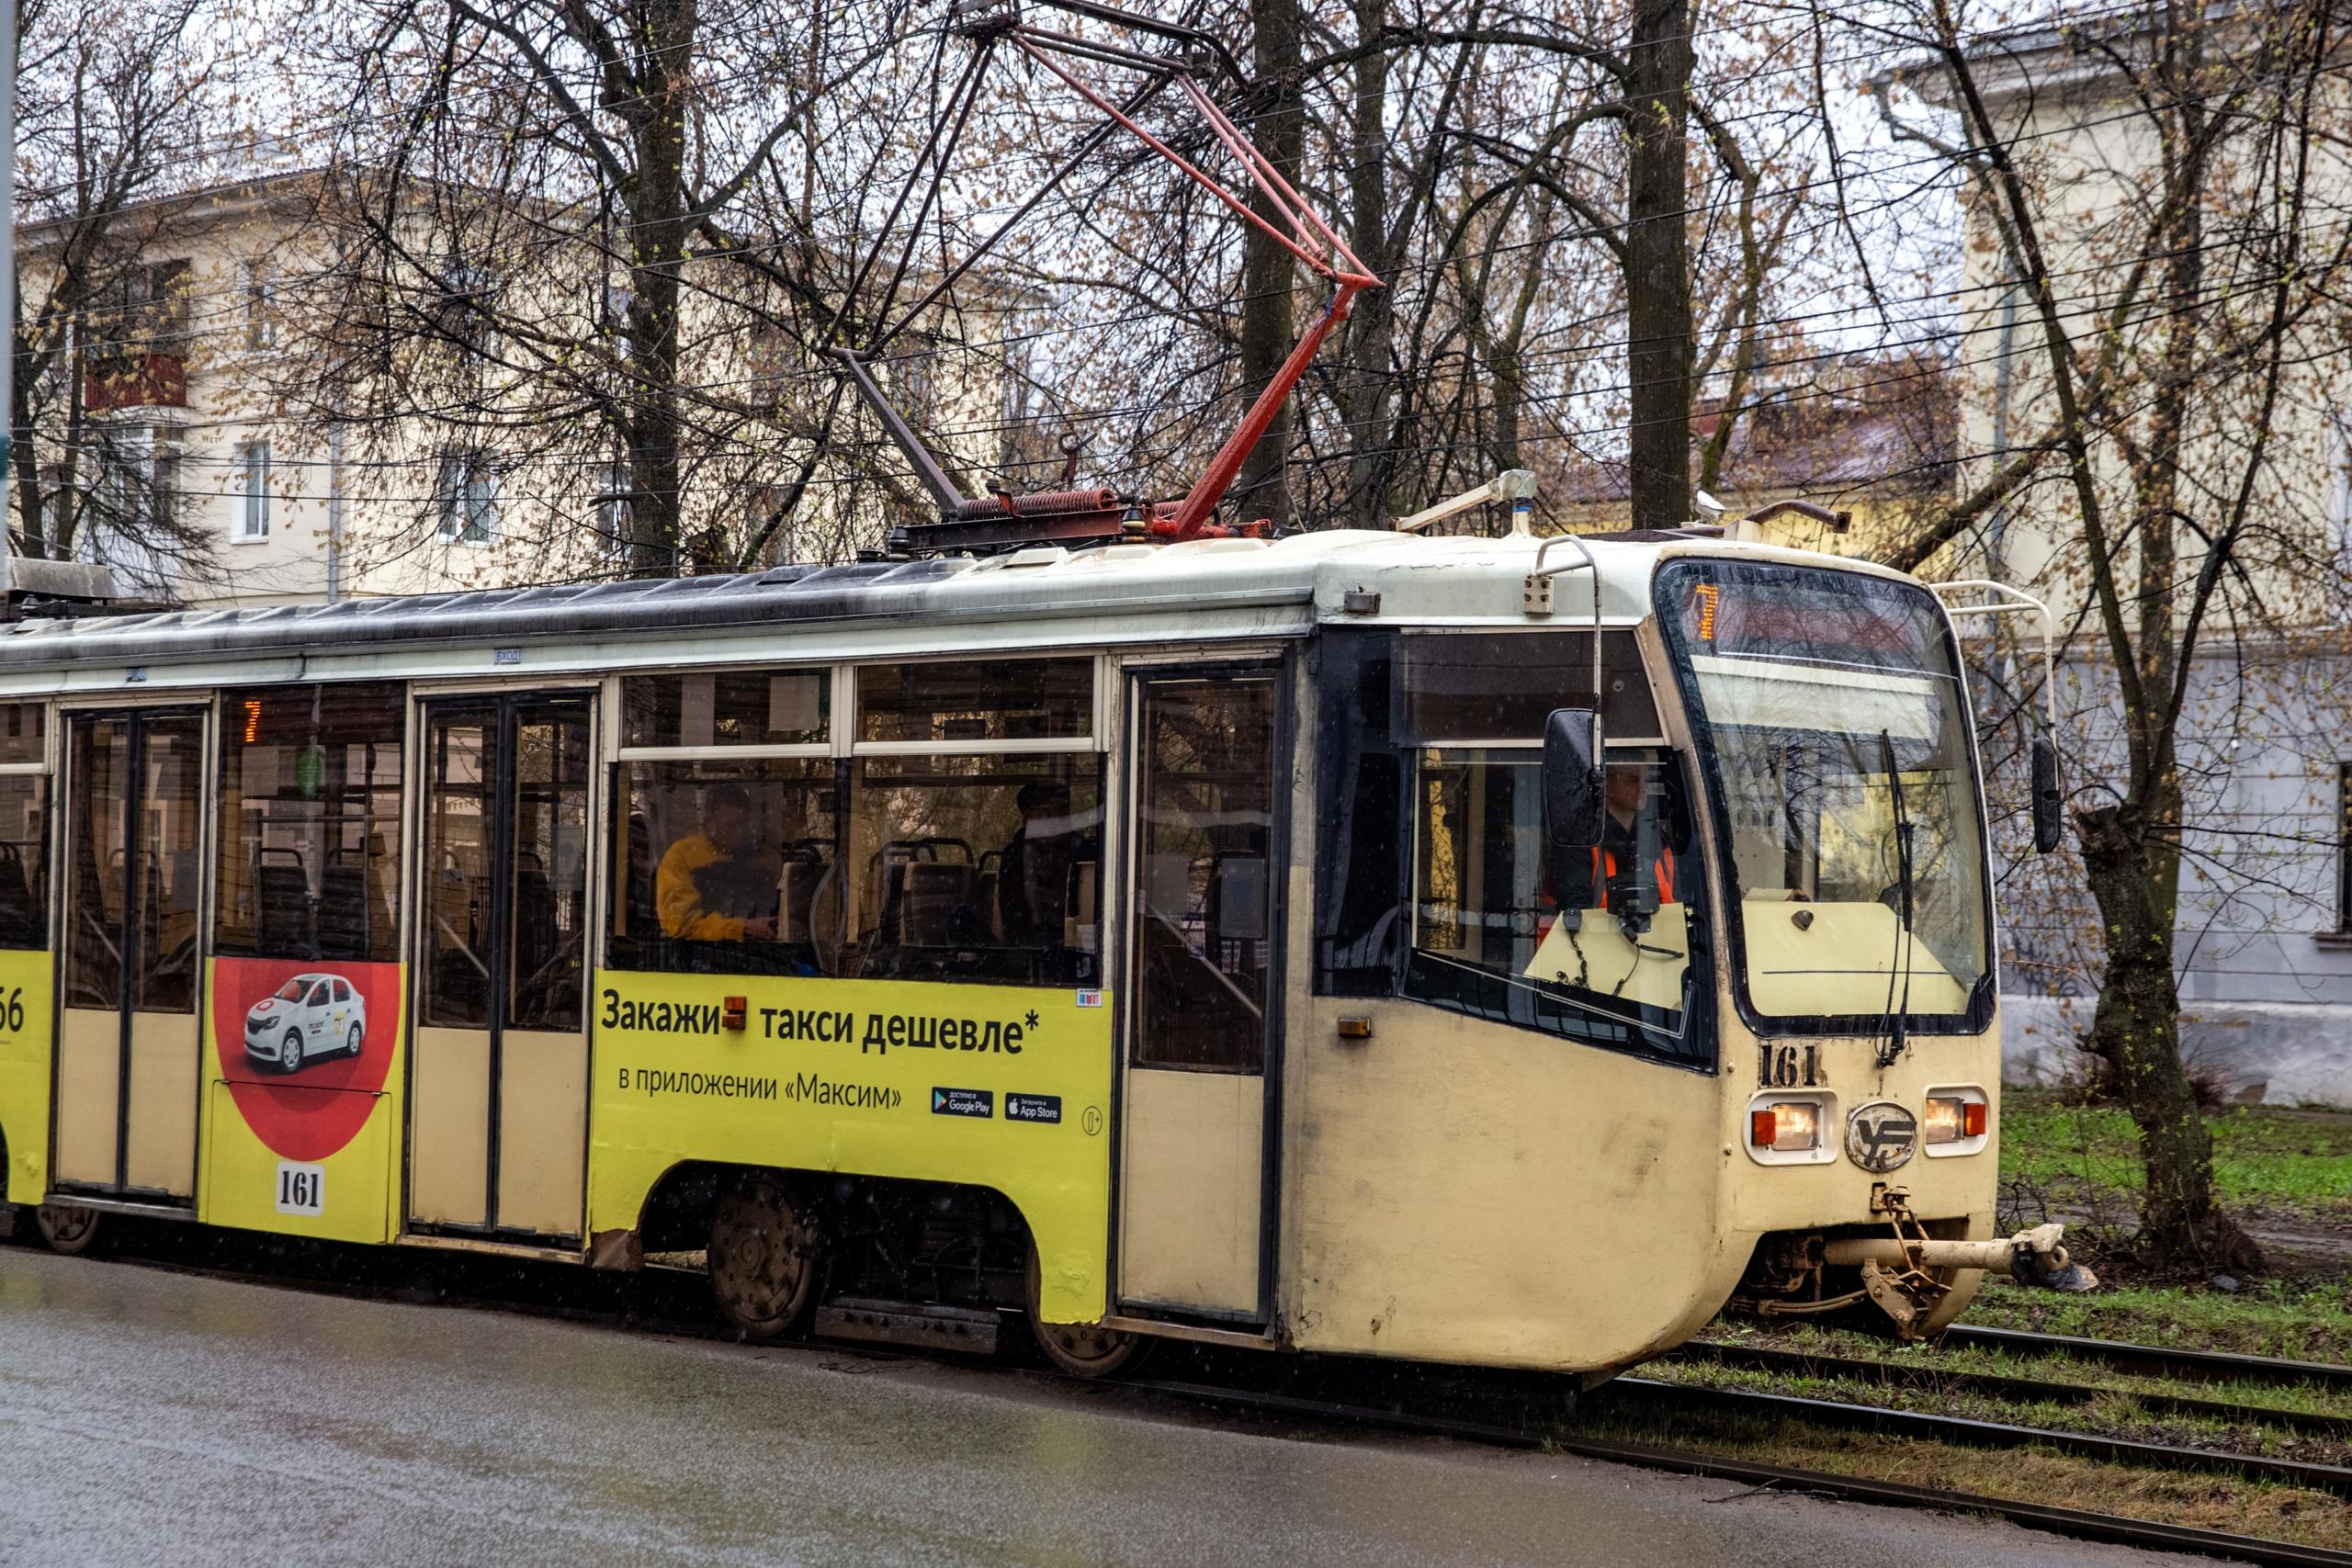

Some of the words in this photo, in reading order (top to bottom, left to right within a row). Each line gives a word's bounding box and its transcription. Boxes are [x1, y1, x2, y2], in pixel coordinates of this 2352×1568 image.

[1696, 583, 1718, 640] 7
[496, 650, 518, 661] ВХОД
[244, 701, 261, 742] 7
[602, 988, 720, 1035] Закажи
[760, 1008, 854, 1043] такси
[1761, 1044, 1817, 1087] 161
[619, 1068, 629, 1089] в
[637, 1069, 777, 1100] приложении
[785, 1071, 902, 1109] «Максим»
[949, 1099, 975, 1113] Google
[975, 1101, 990, 1115] Play
[1021, 1107, 1036, 1119] App
[1037, 1107, 1058, 1119] Store
[280, 1170, 319, 1207] 161
